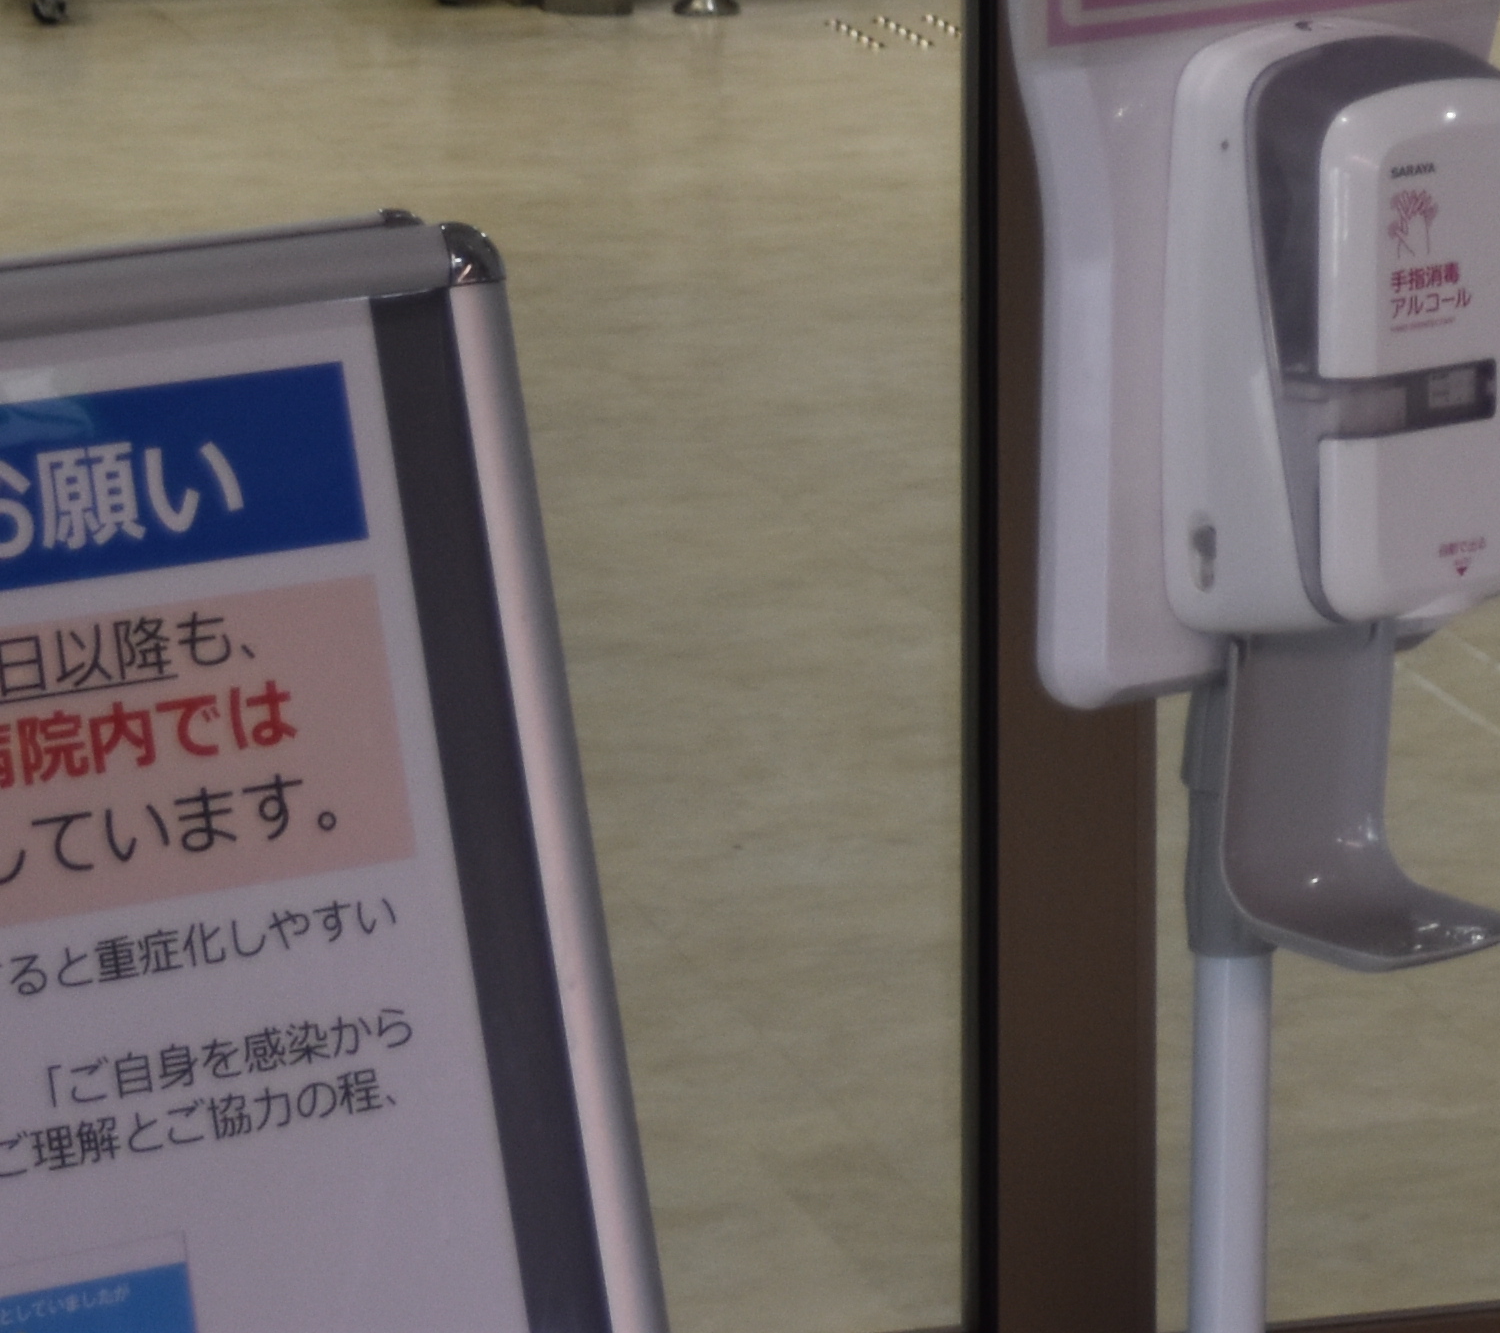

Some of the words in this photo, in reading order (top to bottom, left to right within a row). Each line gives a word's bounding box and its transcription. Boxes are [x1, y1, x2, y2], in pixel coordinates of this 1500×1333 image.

[1391, 162, 1436, 179] SARAYA
[1391, 261, 1459, 293] 手指消毒
[1390, 288, 1472, 319] アルコール
[0, 680, 298, 789] 院内では
[47, 1008, 414, 1109] 「ご自身を感染から
